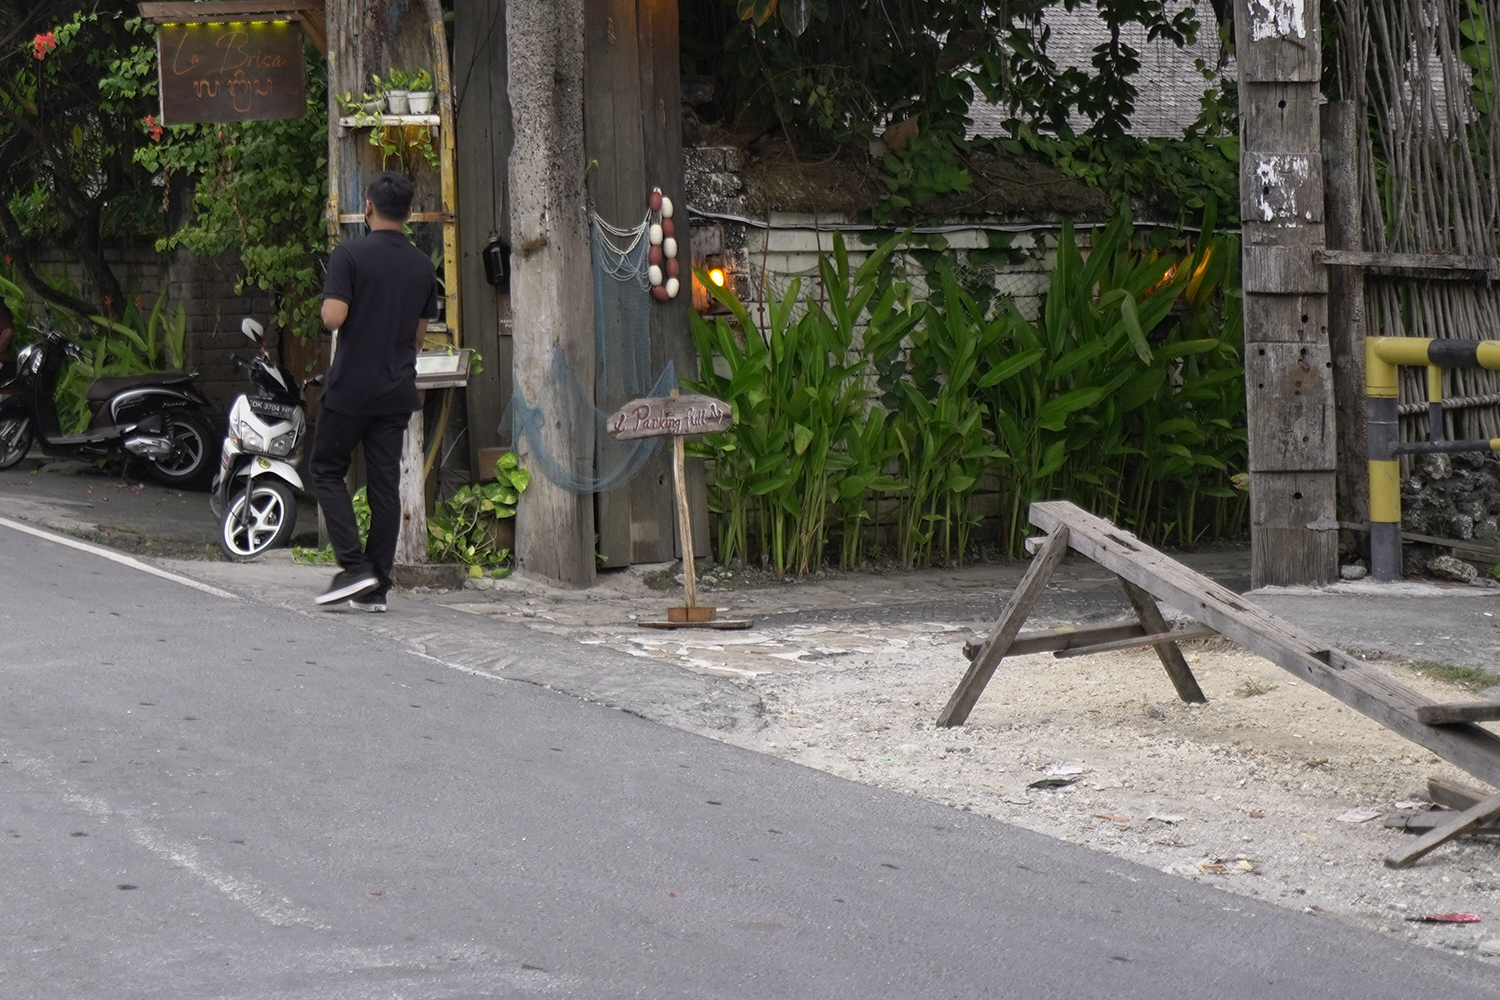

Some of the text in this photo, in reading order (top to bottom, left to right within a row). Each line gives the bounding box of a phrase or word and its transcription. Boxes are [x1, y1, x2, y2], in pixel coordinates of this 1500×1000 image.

[173, 30, 286, 76] La Brisa
[631, 404, 706, 434] Parking full
